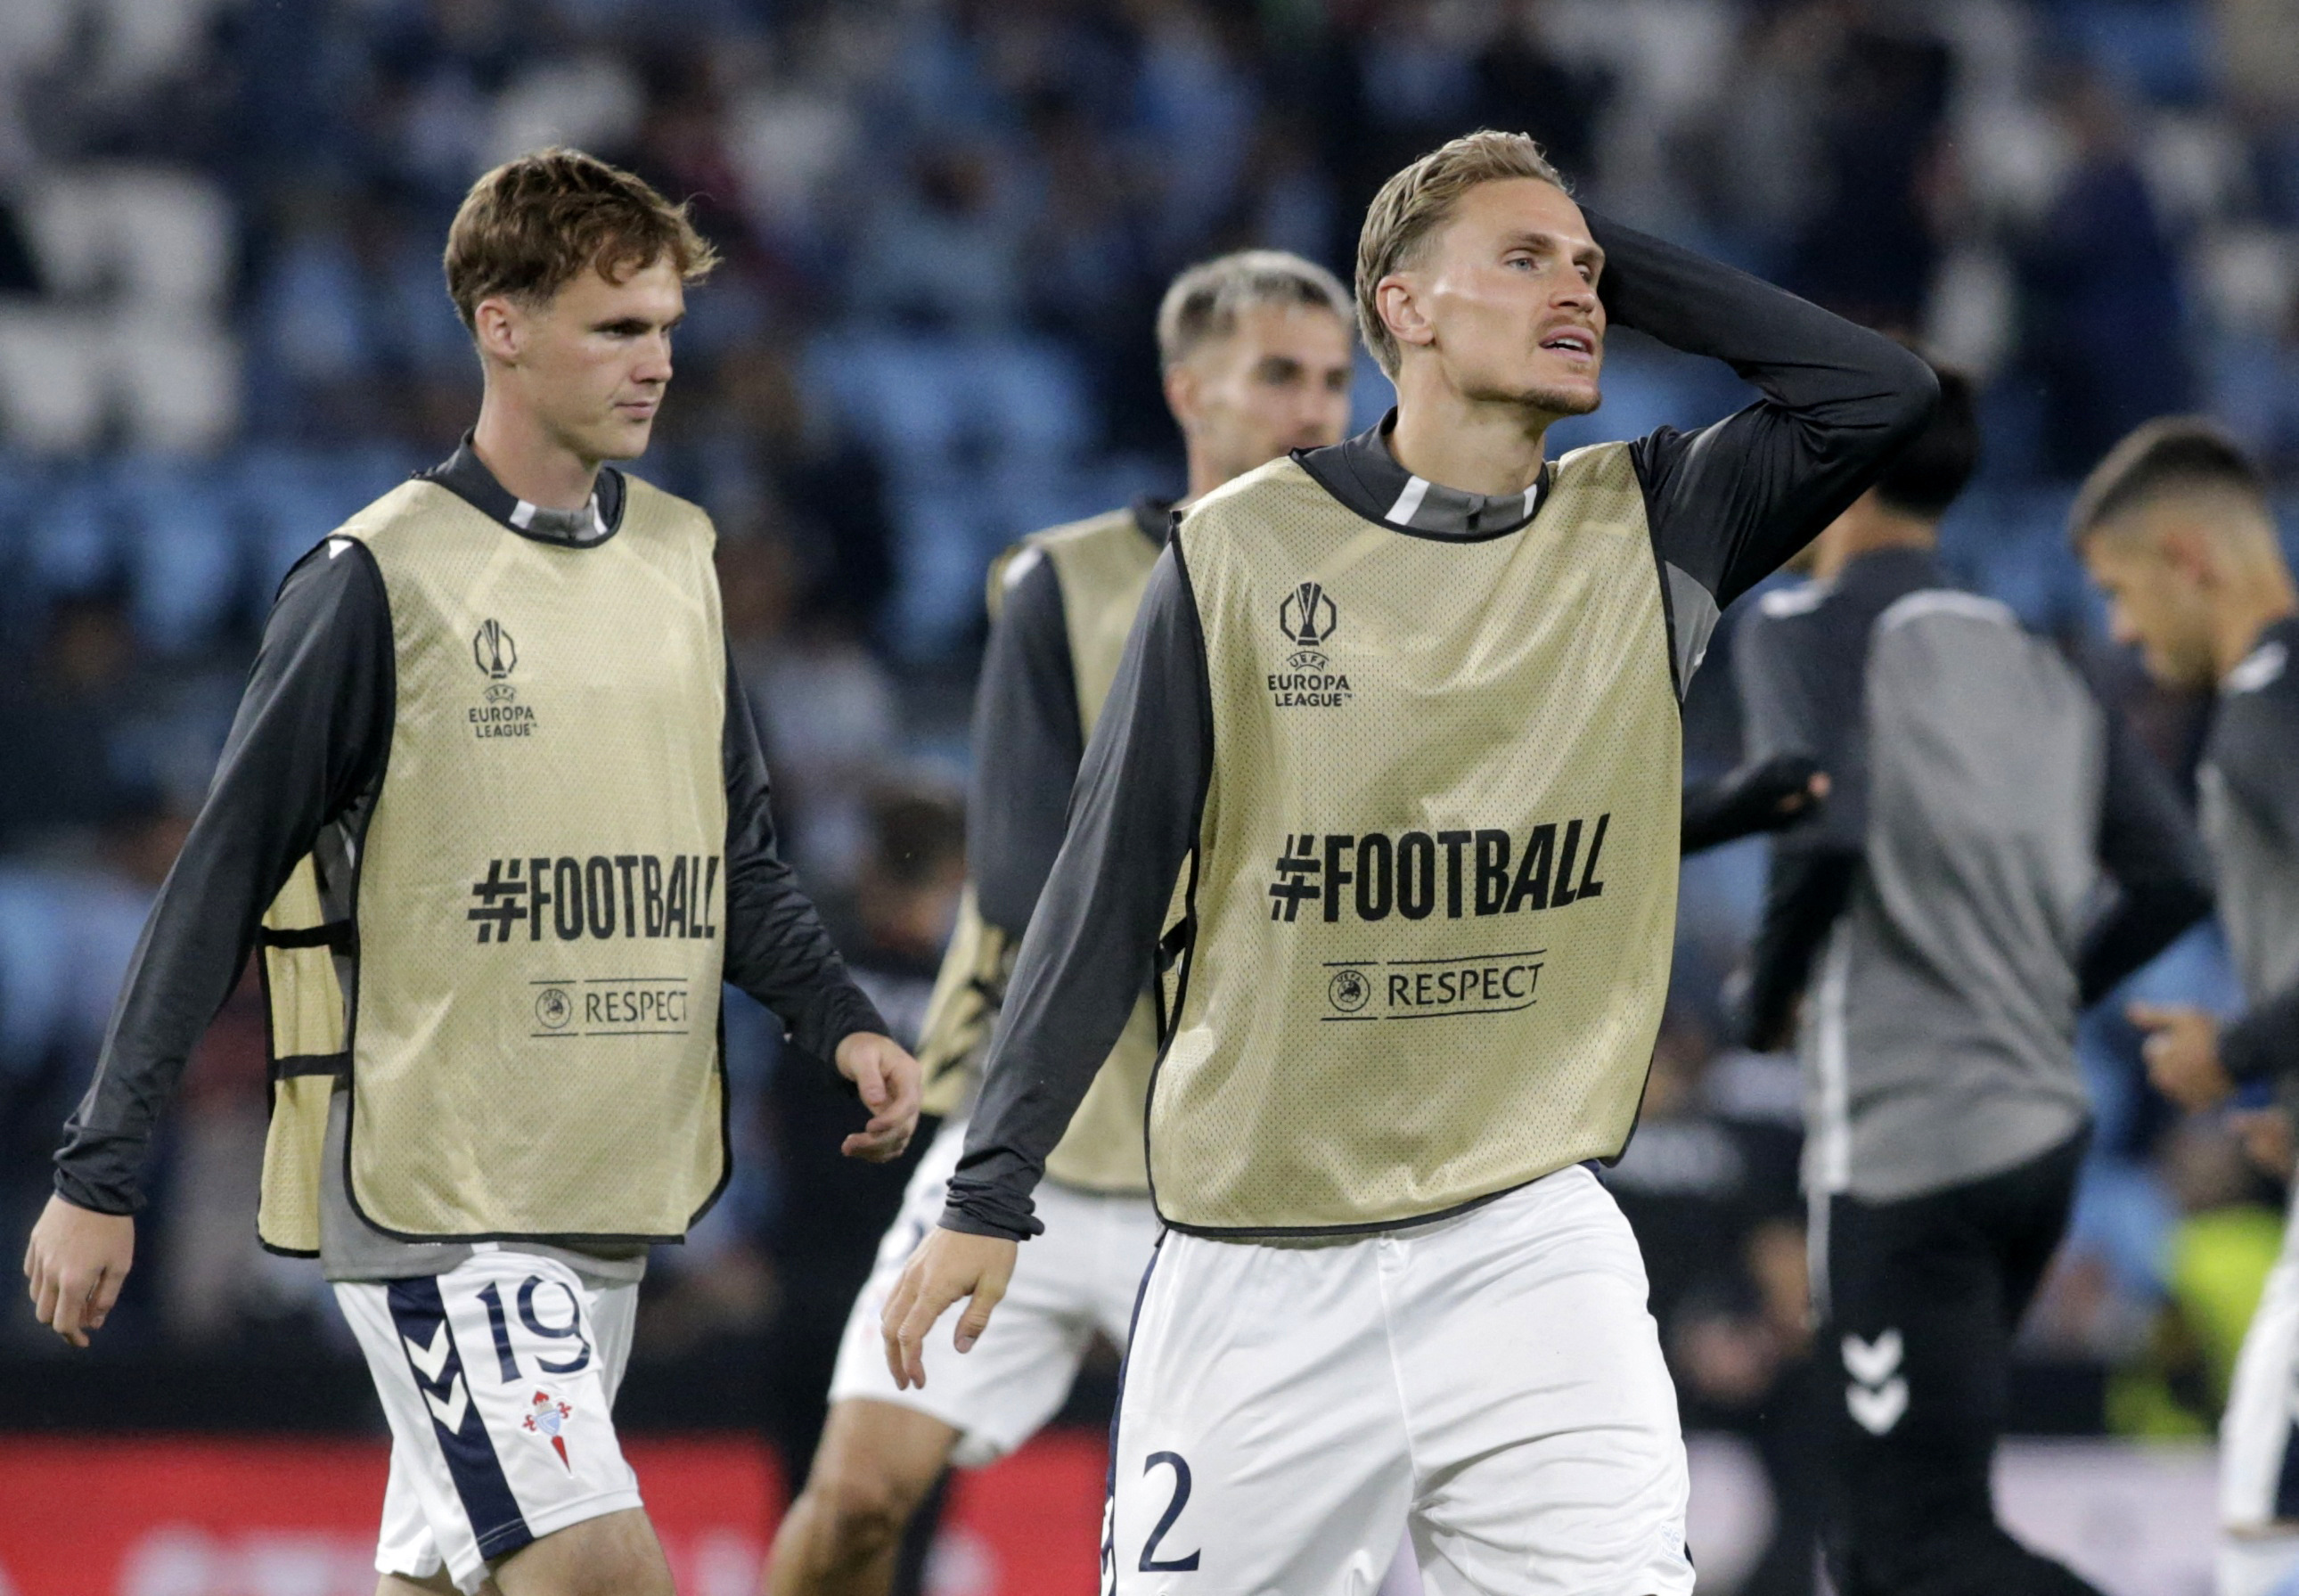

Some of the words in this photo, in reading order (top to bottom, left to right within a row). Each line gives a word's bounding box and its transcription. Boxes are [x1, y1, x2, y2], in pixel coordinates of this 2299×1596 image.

[1267, 675, 1350, 690] EUROPA
[1289, 653, 1326, 669] UEFA
[469, 706, 534, 722] EUROPA
[1269, 813, 1611, 922] #FOOTBALL
[467, 855, 720, 944] #FOOTBALL
[1387, 962, 1545, 1006] RESPECT
[585, 991, 687, 1023] RESPECT
[475, 1274, 591, 1385] 19
[1138, 1450, 1201, 1573] 2
